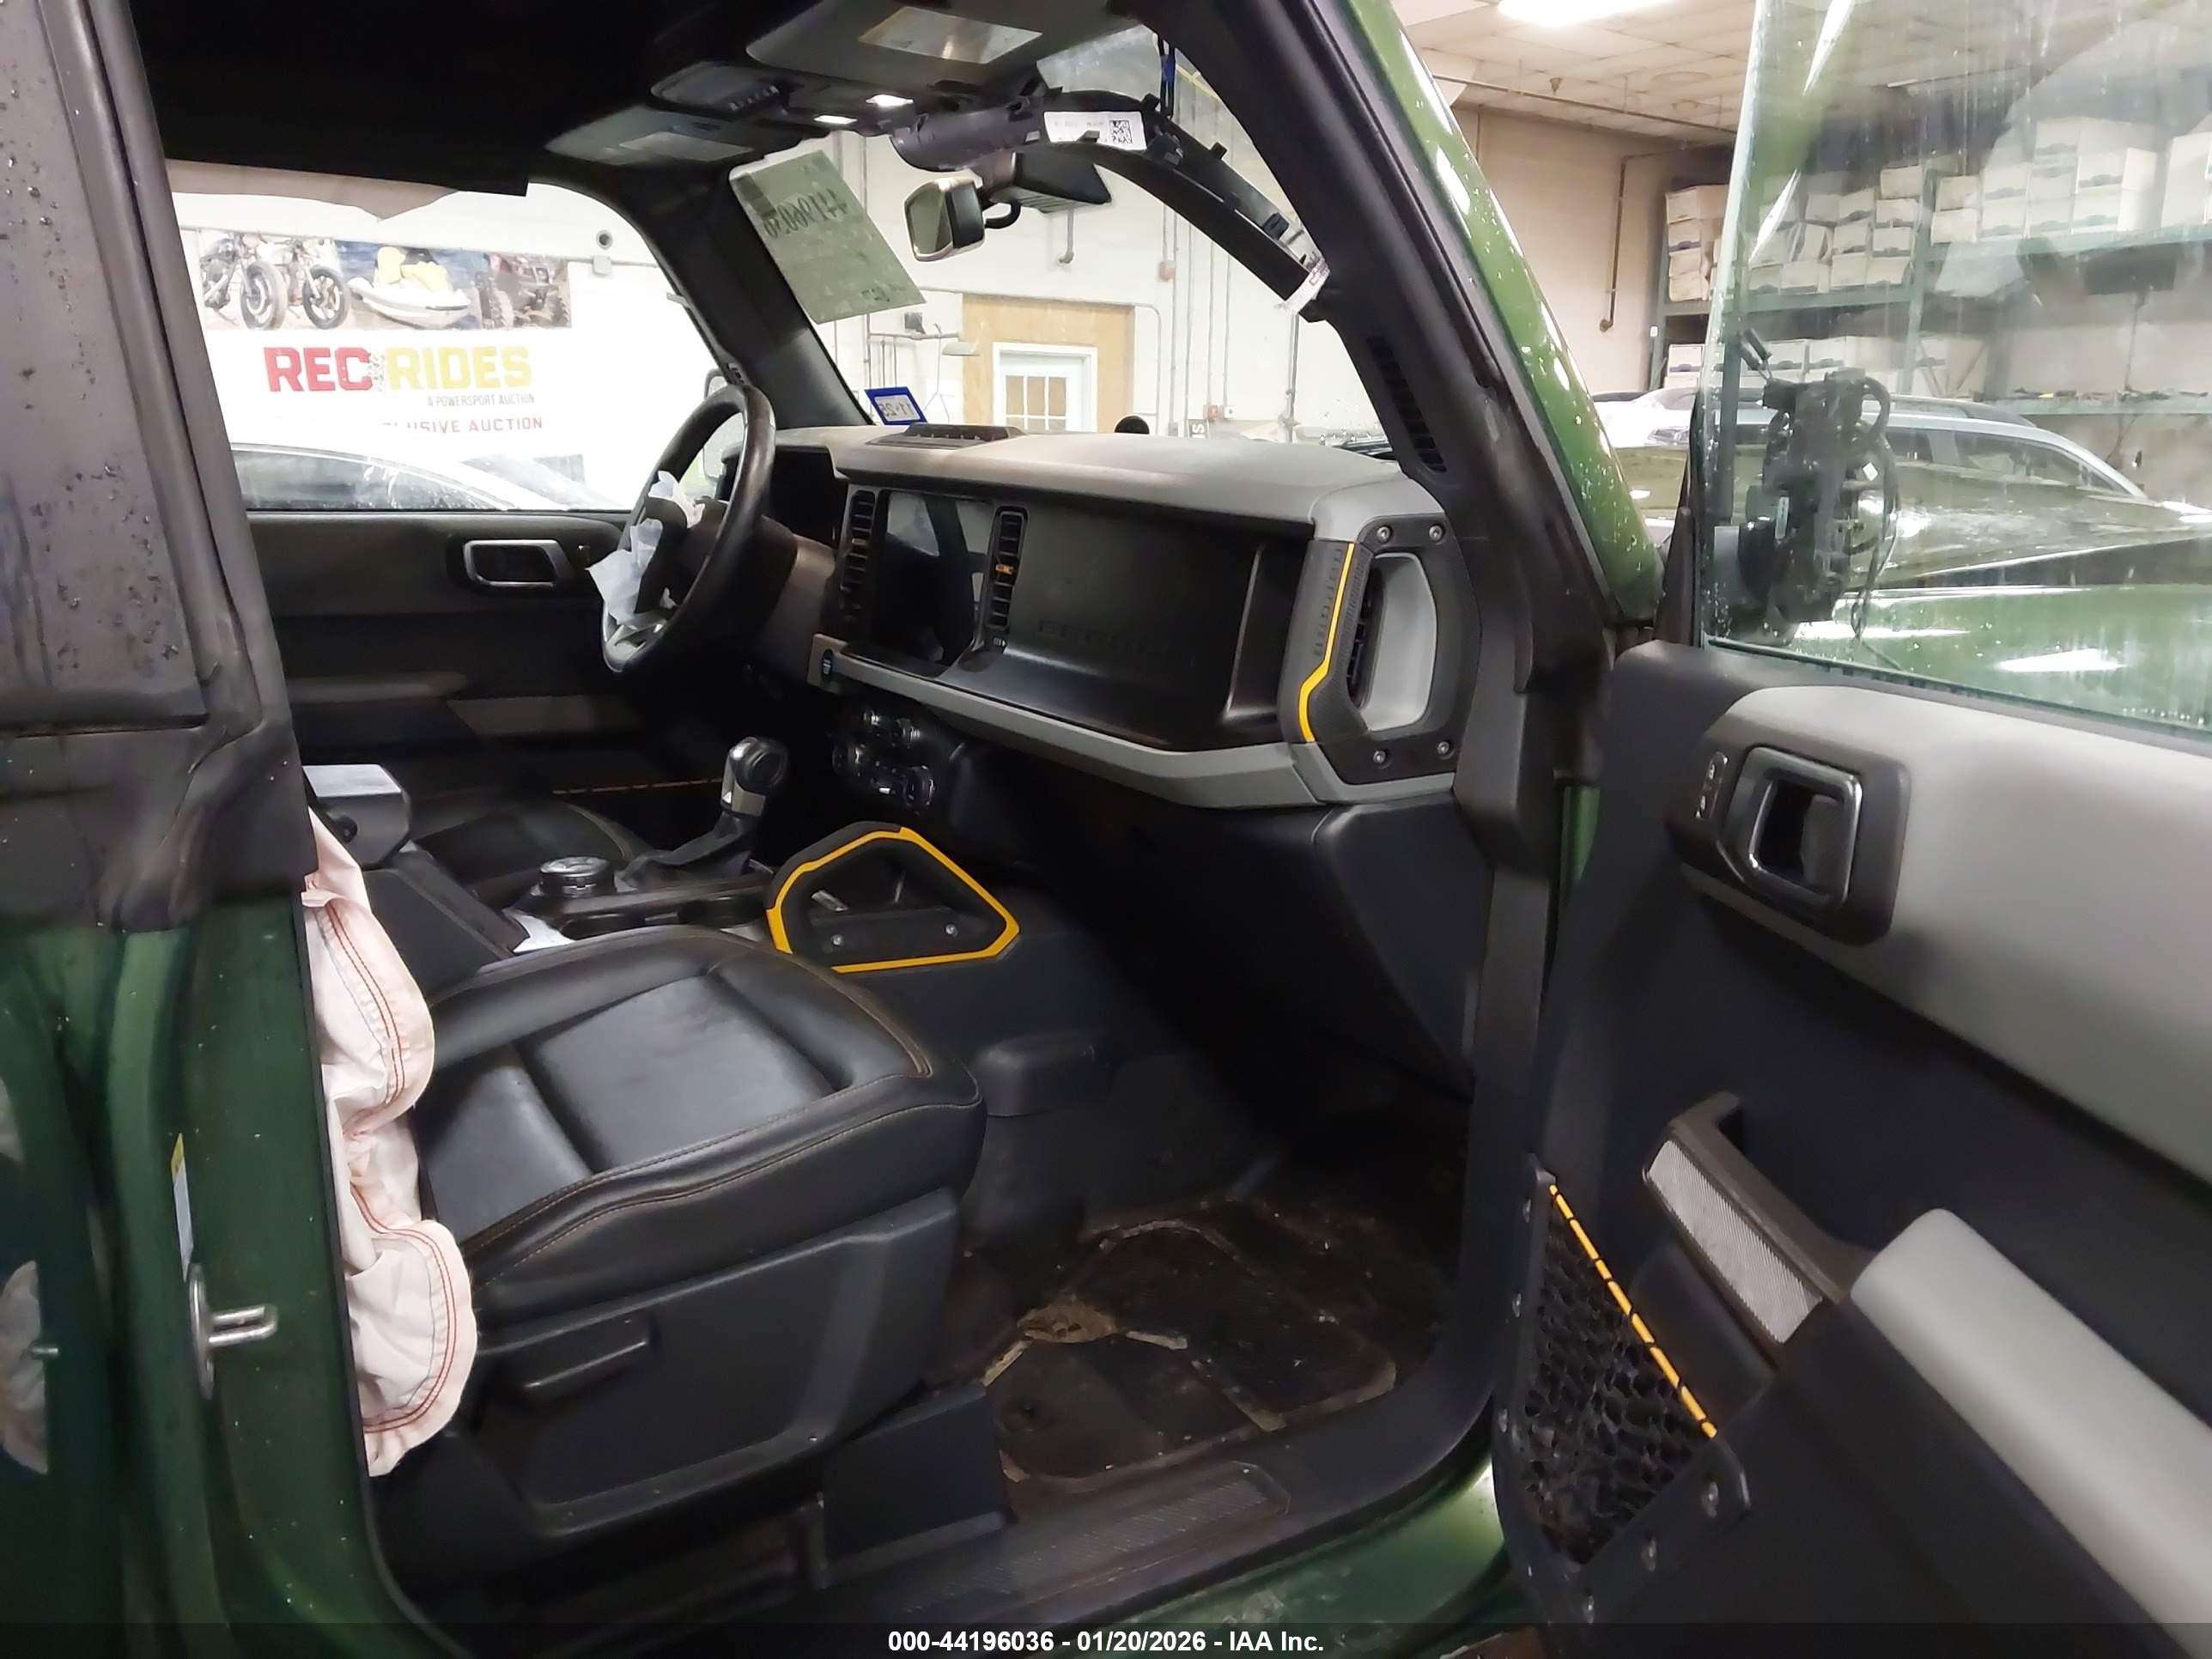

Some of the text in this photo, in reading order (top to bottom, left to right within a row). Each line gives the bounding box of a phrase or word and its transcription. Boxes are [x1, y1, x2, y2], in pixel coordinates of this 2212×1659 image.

[264, 345, 532, 392] REC RIDES
[427, 392, 534, 408] A POWERSPORT AUCTION
[468, 416, 543, 432] AUCTION
